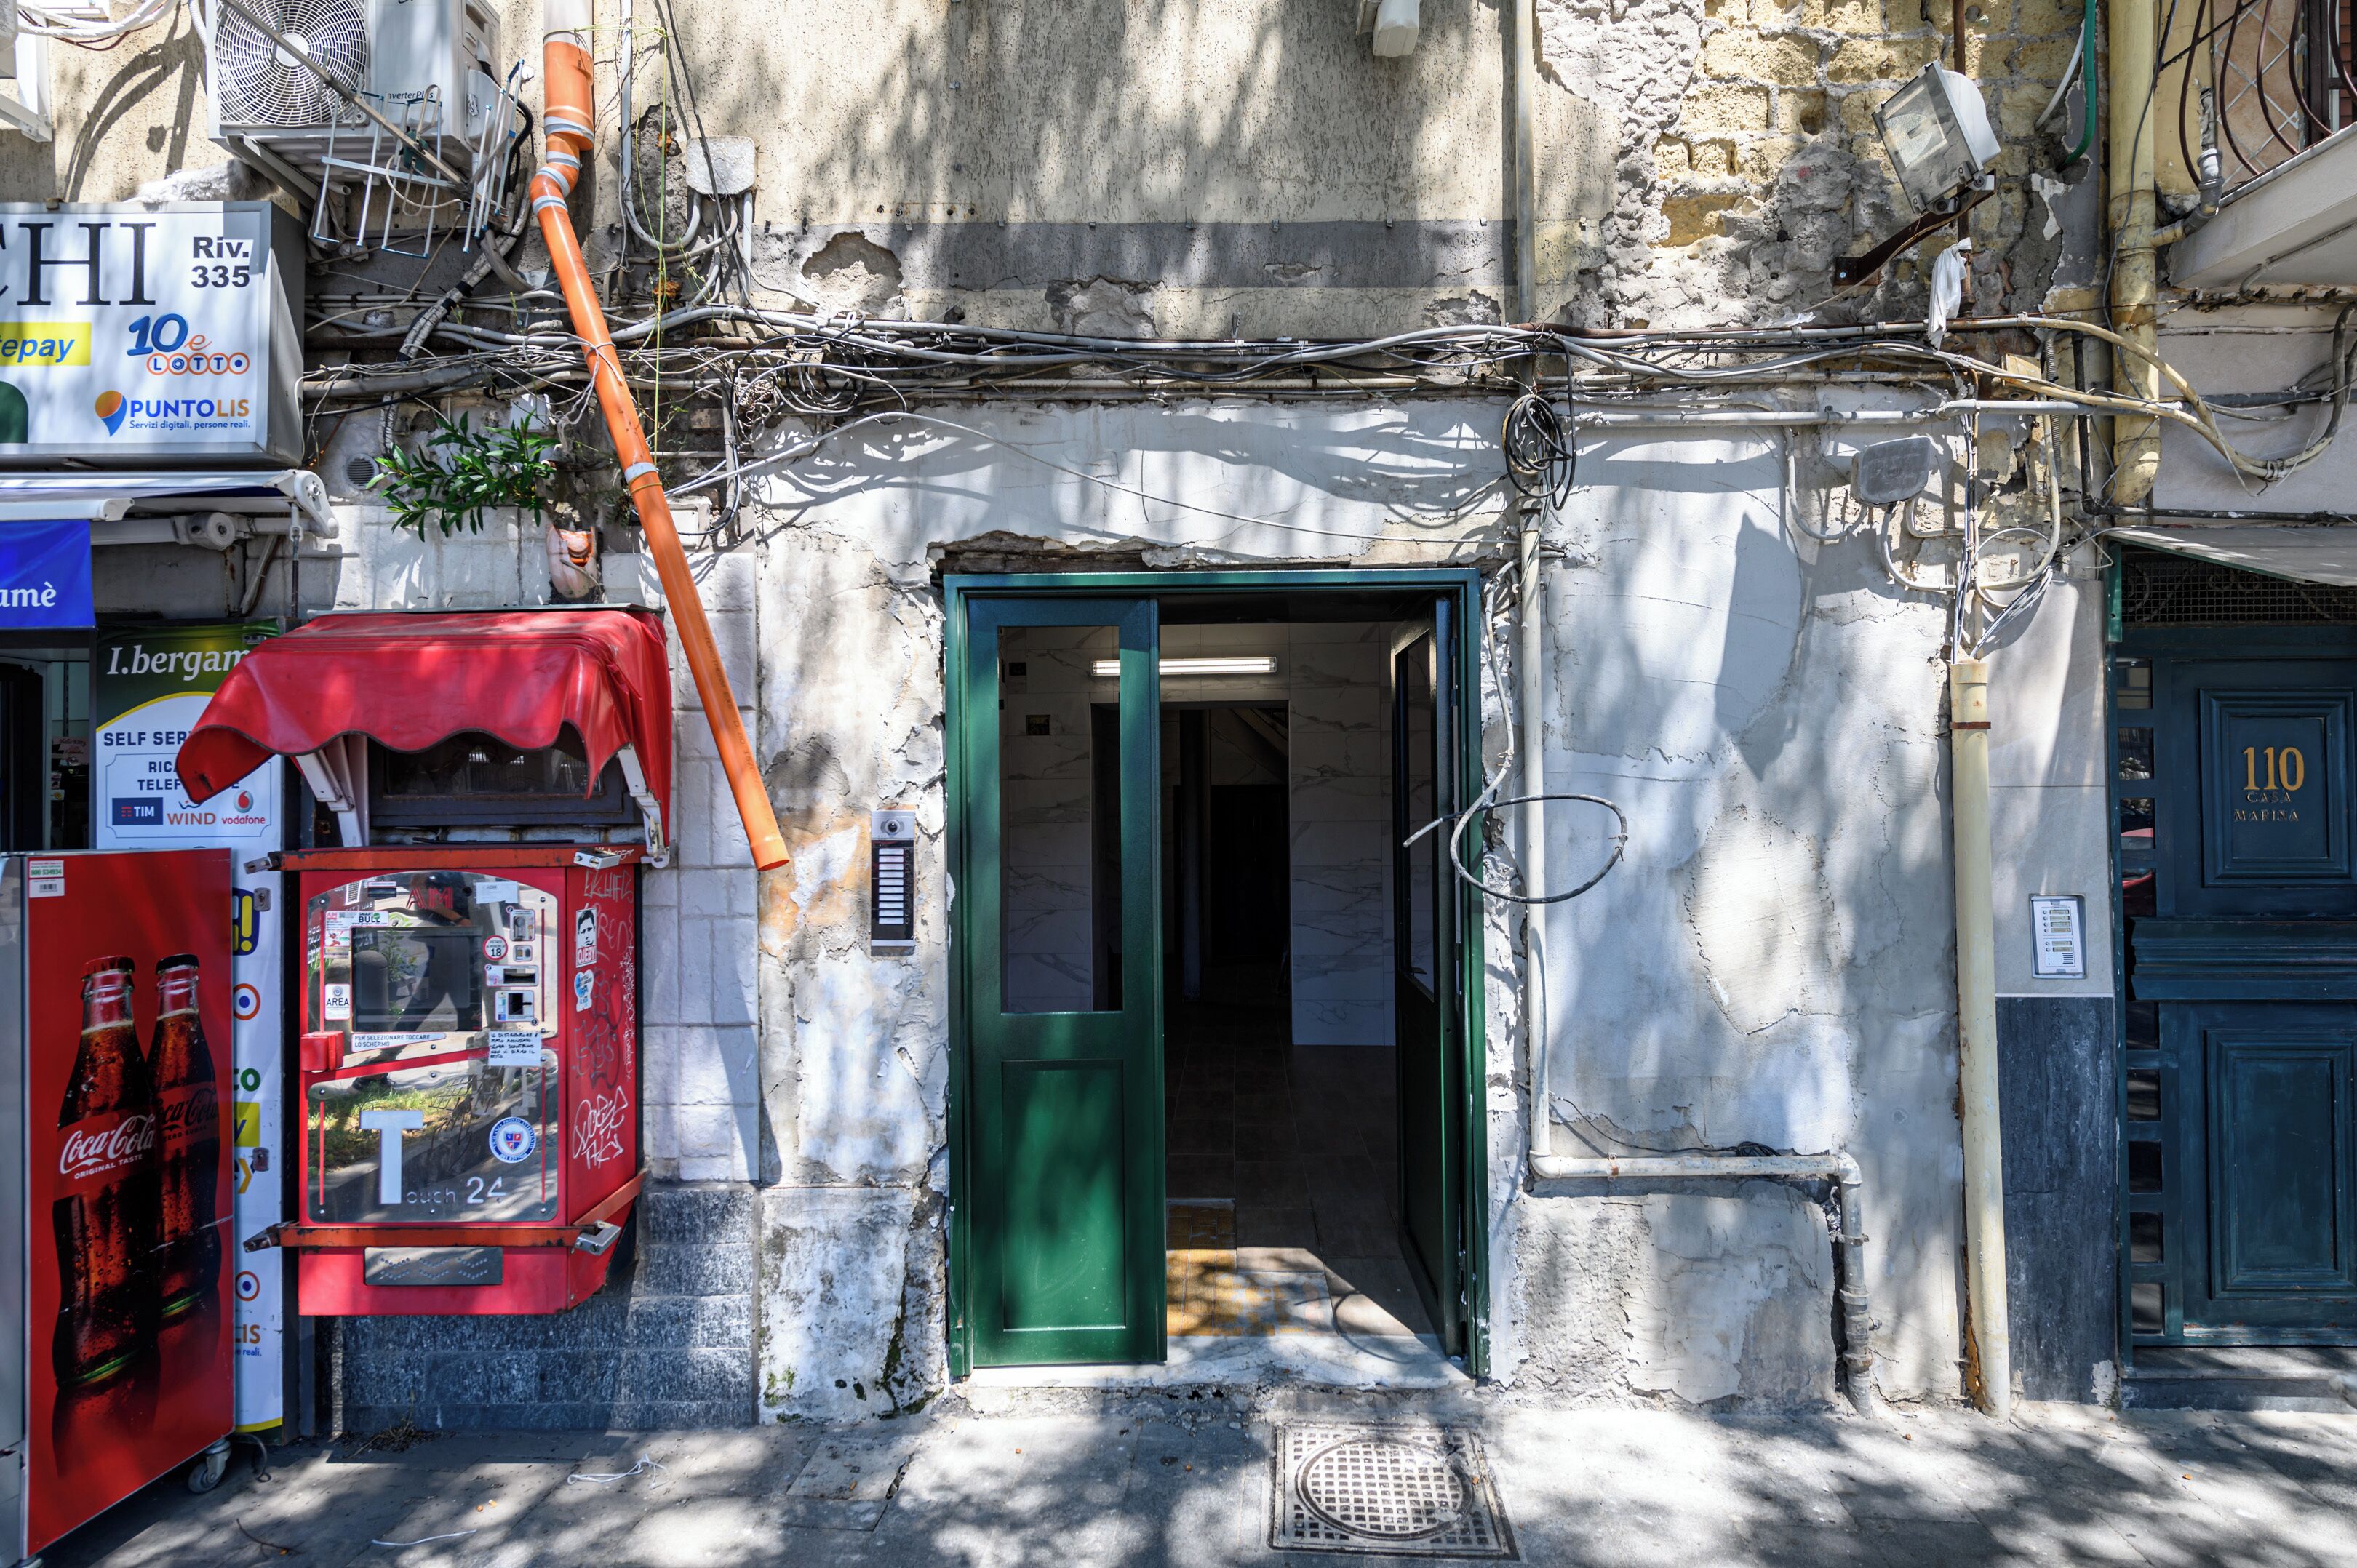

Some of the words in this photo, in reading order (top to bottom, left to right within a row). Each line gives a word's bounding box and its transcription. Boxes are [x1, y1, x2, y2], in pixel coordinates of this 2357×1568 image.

[193, 236, 249, 258] Riv.
[191, 265, 250, 288] 335
[127, 313, 188, 356] 10
[0, 335, 76, 363] epay
[148, 354, 248, 375] LOTTO
[130, 399, 250, 417] PUNTOLIS
[129, 420, 158, 429] Servizi
[160, 420, 191, 431] digitali,
[194, 422, 228, 431] persone
[231, 420, 250, 429] reali.
[103, 732, 146, 746] SELF
[2243, 746, 2305, 791] 110
[2246, 791, 2291, 803] CASA
[134, 806, 155, 817] TIM
[167, 812, 216, 825] WIND
[222, 815, 266, 825] vodafone
[2234, 809, 2299, 822] MARINA
[490, 948, 502, 957] 18
[326, 998, 349, 1007] AREA
[60, 1113, 155, 1175] Coca-Cola
[74, 1163, 116, 1180] ORIGINAL
[118, 1153, 143, 1165] TASTE
[466, 1176, 506, 1204] 24
